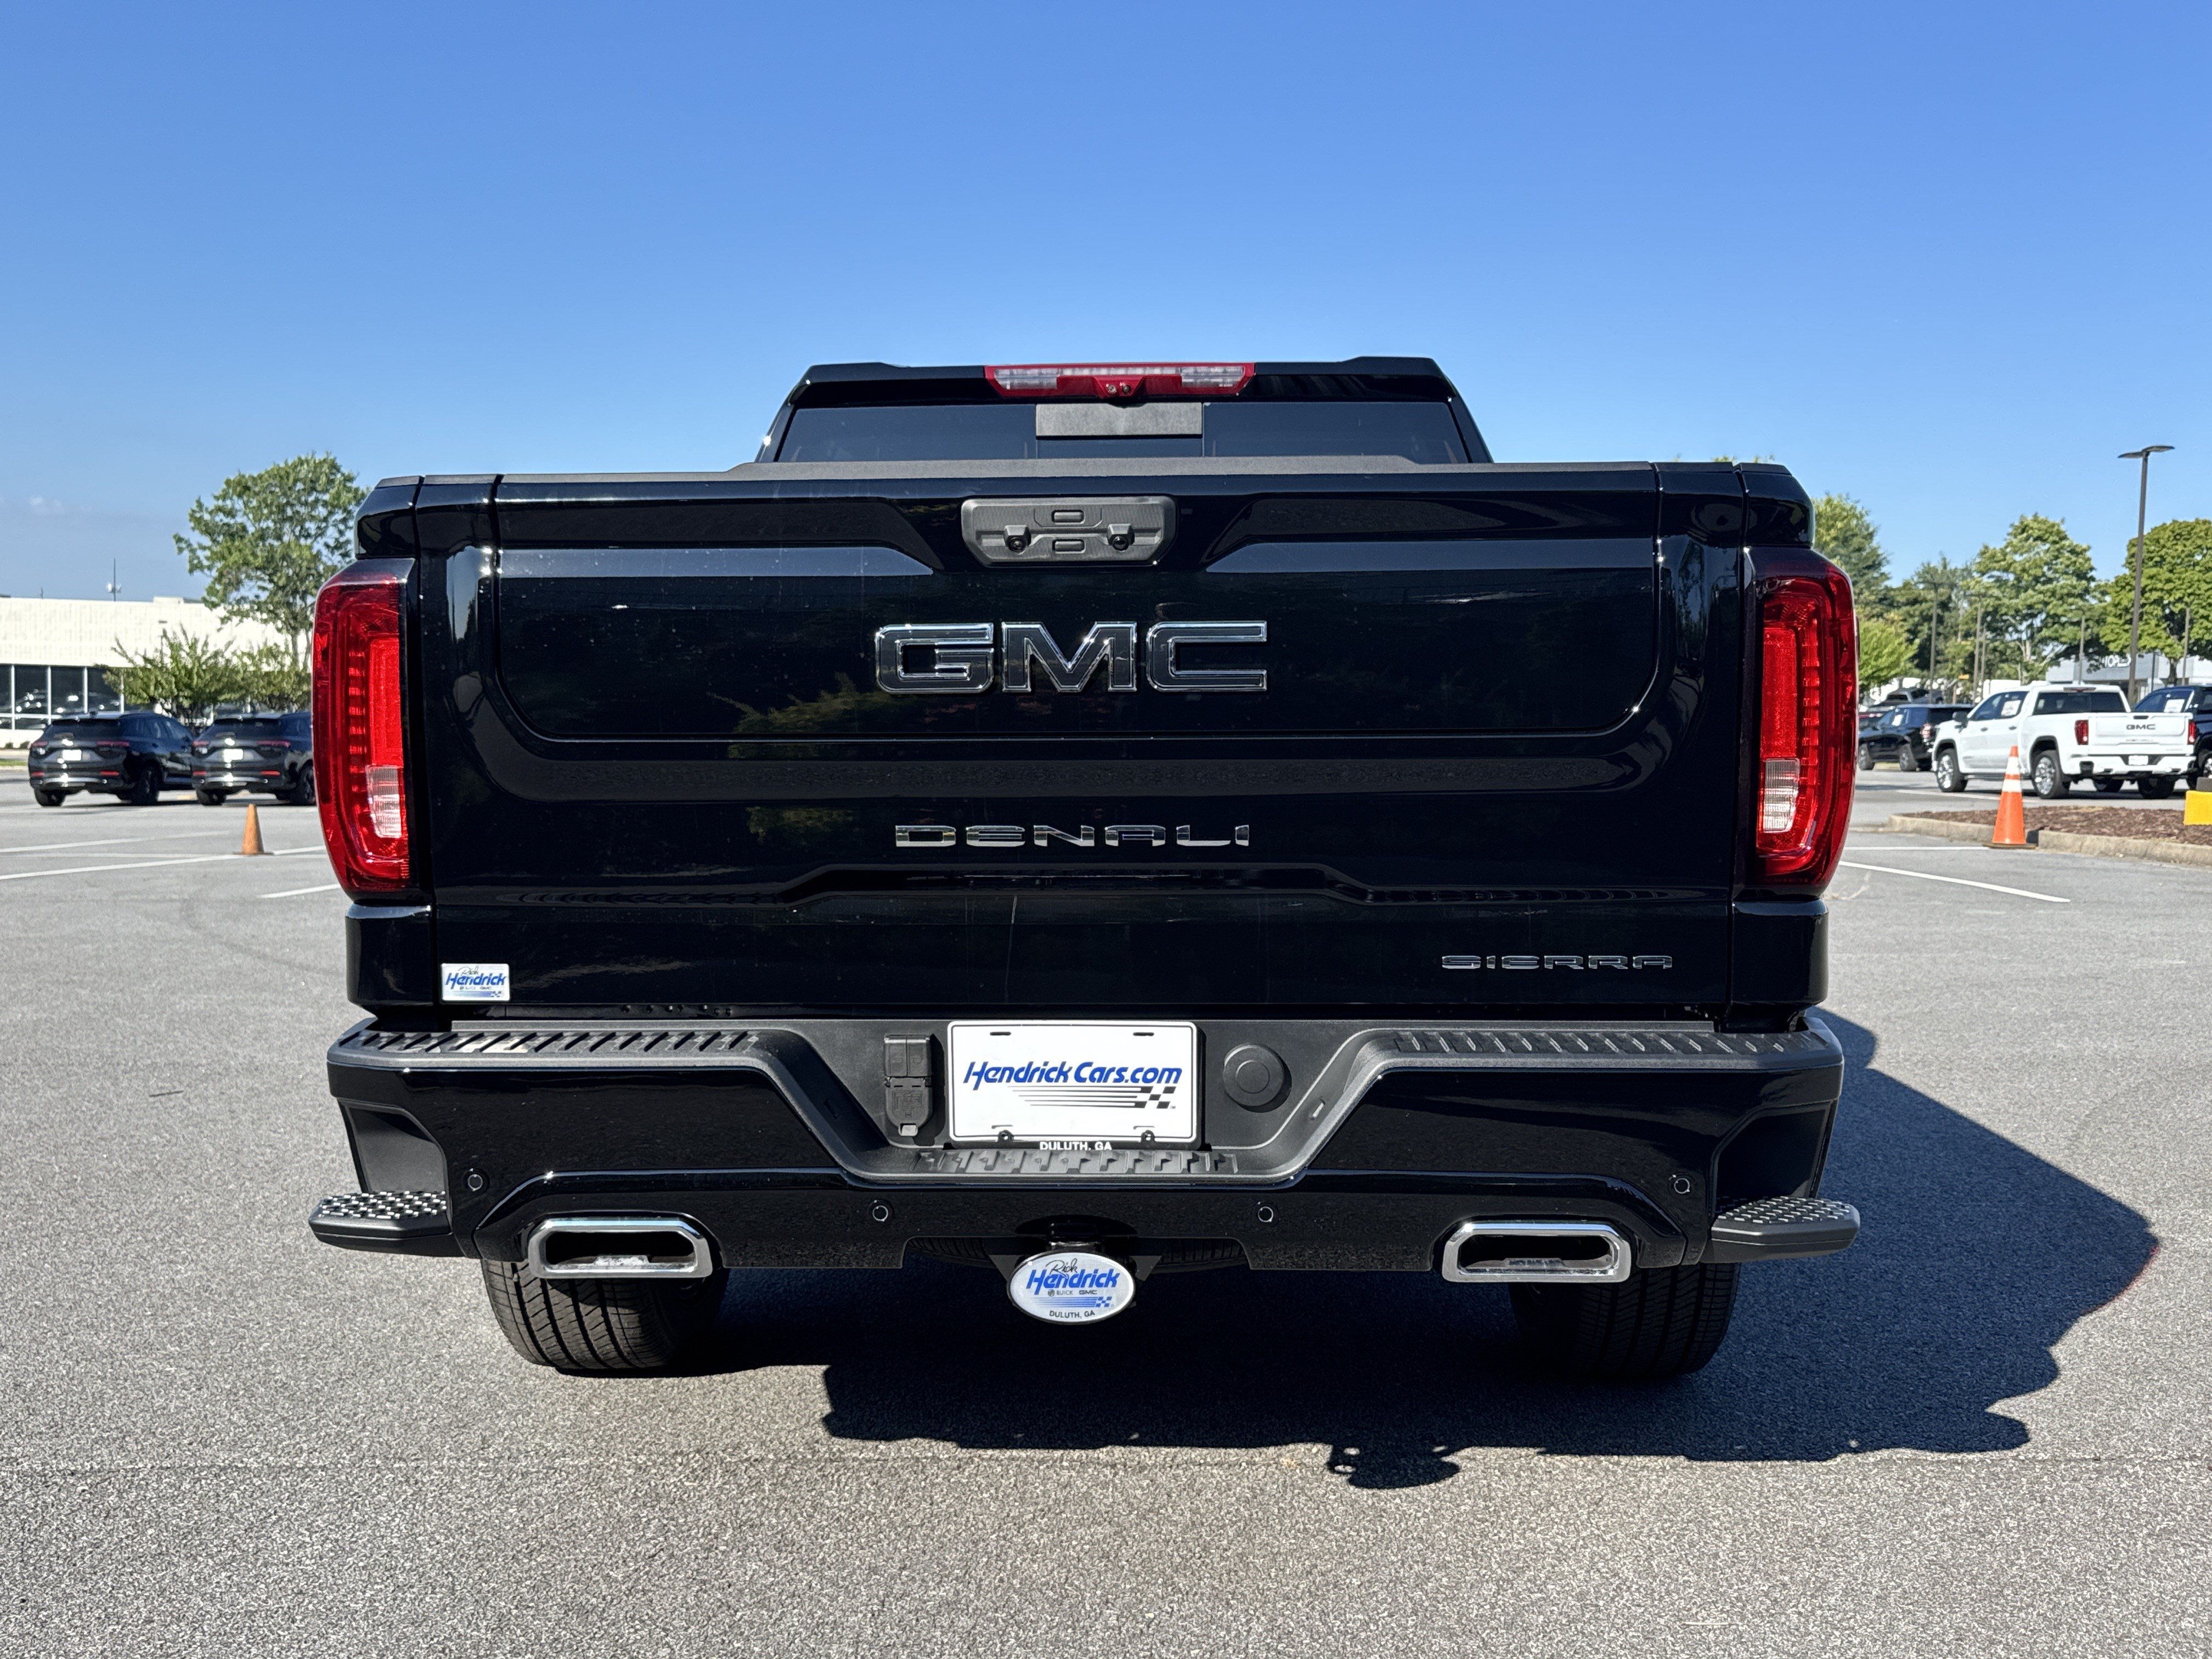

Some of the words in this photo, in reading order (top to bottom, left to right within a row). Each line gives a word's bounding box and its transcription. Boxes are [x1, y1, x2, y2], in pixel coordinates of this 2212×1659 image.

[874, 620, 1267, 693] GMC
[895, 825, 1250, 847] DENALI
[1442, 955, 1673, 969] SIERRA
[445, 973, 507, 989] Hendrick
[1094, 1141, 1113, 1150] GA
[1026, 1268, 1121, 1295] Hendrick
